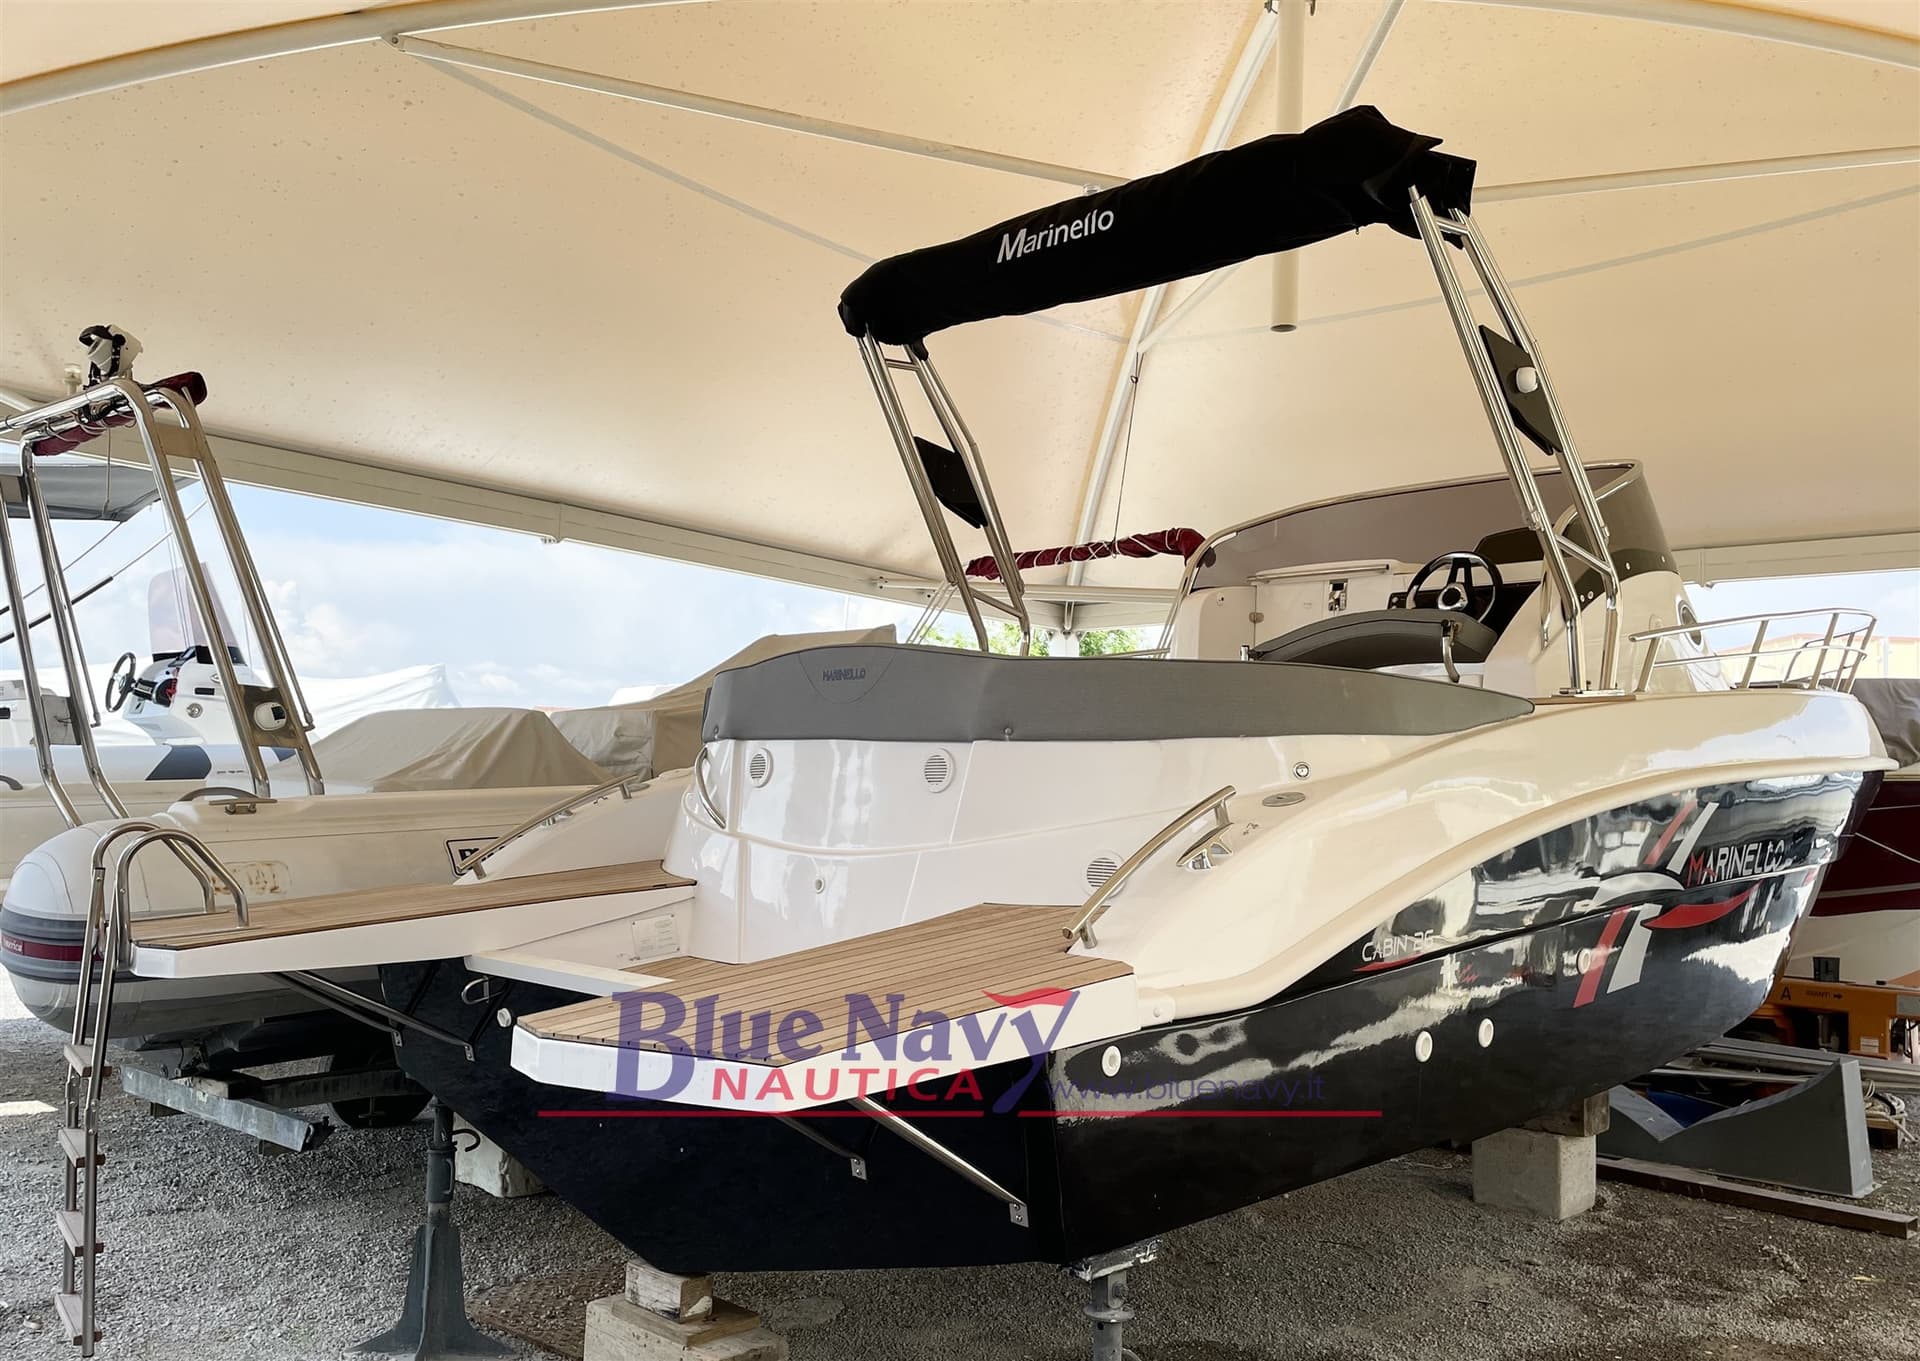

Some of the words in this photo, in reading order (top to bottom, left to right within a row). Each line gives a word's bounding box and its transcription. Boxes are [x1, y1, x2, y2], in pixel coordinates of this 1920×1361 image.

[996, 208, 1115, 264] Marinello
[822, 667, 866, 681] MARINELLO
[1361, 935, 1408, 962] CABIN
